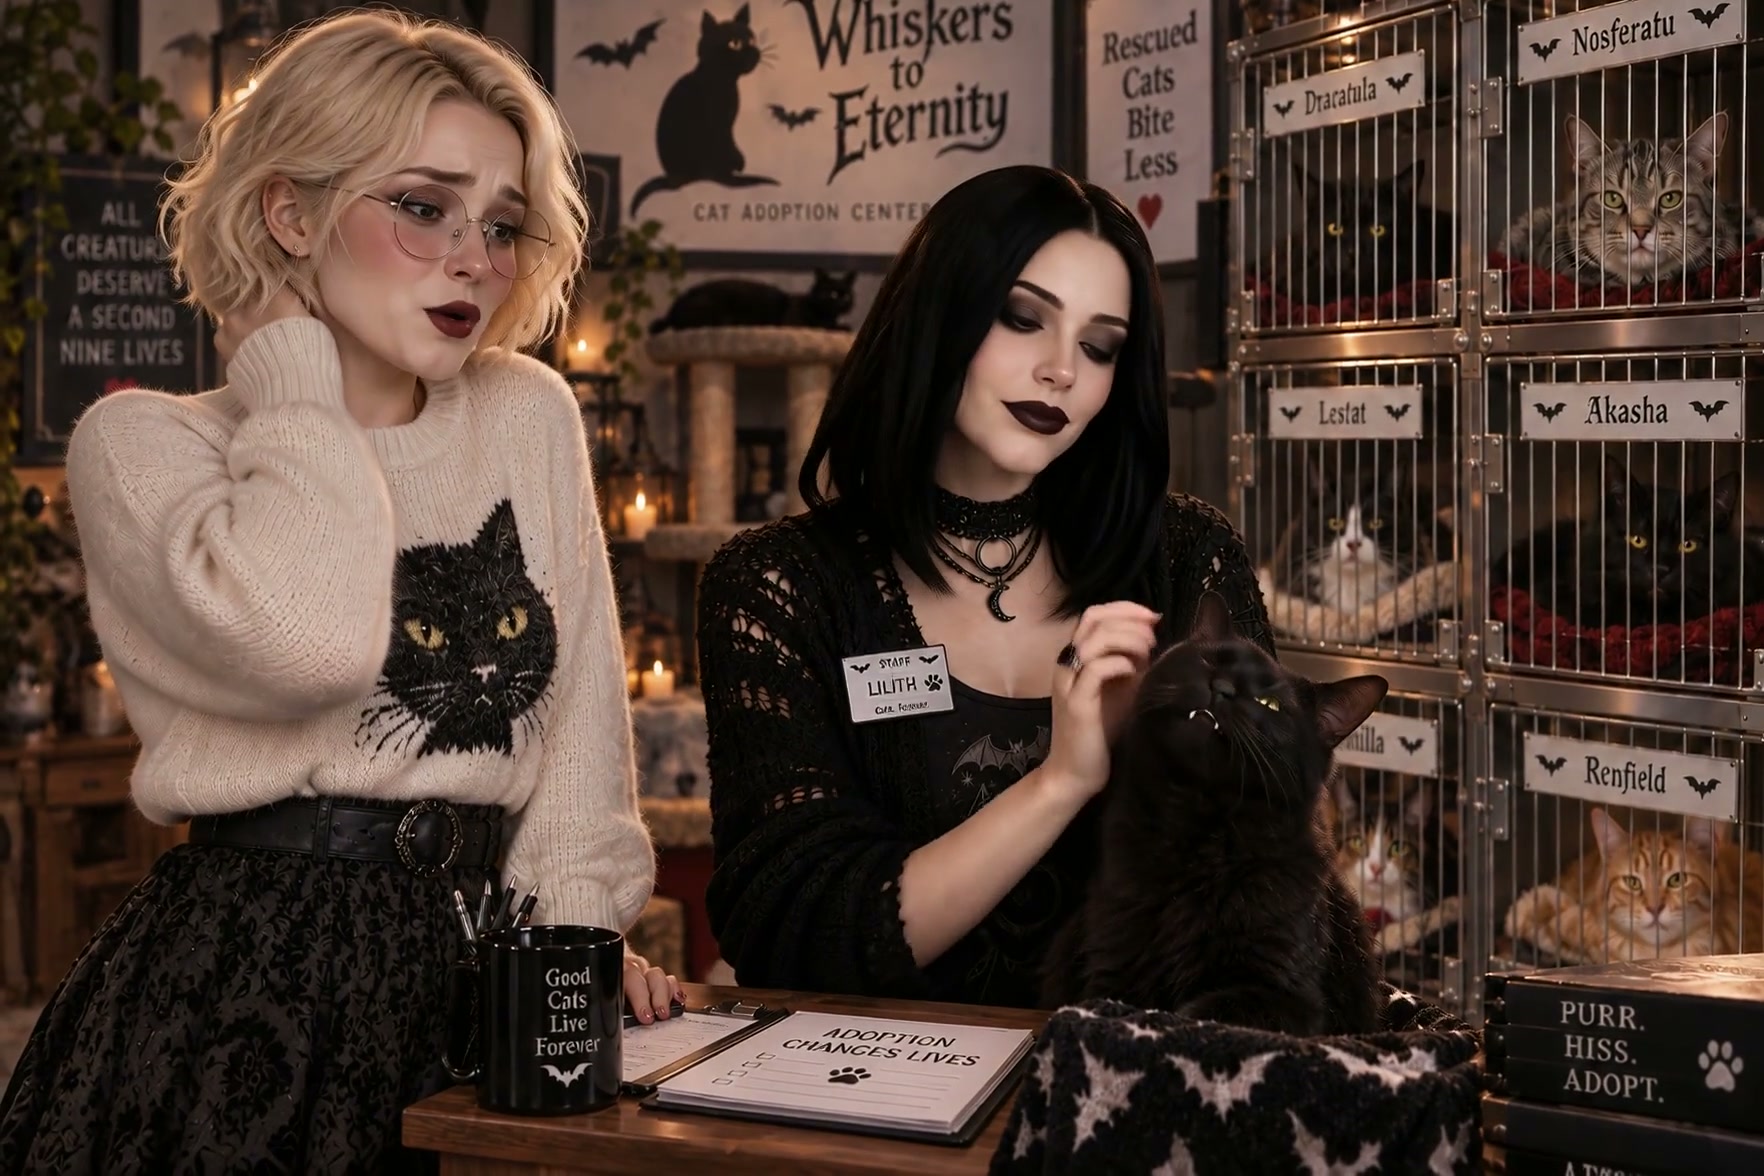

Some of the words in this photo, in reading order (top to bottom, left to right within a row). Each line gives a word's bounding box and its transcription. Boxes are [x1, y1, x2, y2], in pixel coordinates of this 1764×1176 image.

[782, 0, 1013, 71] Whiskers
[1102, 10, 1198, 66] Rescued
[1572, 11, 1676, 56] Nosferatu
[890, 56, 924, 91] to
[1122, 64, 1176, 100] Cats
[1305, 76, 1377, 116] Dracatula
[826, 83, 1009, 186] Eternity
[1126, 104, 1175, 140] Bite
[1124, 148, 1178, 182] Less
[101, 201, 142, 227] ALL
[693, 203, 730, 222] CAT
[741, 203, 839, 222] ADOPTION
[60, 233, 163, 262] CREATUR
[67, 303, 84, 330] A
[91, 303, 176, 331] SECOND
[60, 338, 115, 366] NINE
[123, 338, 185, 366] LIVES
[1318, 400, 1366, 425] Lestat
[1584, 395, 1668, 424] Akasha
[878, 655, 911, 669] STAFF
[867, 676, 918, 697] LILITH
[1584, 755, 1666, 794] Renfield
[545, 966, 591, 987] Good
[547, 990, 588, 1010] Cats
[550, 1014, 588, 1033] Live
[1560, 1000, 1645, 1031] PURR.
[535, 1037, 600, 1056] Forever
[823, 1027, 956, 1048] ADOPTION
[1564, 1034, 1637, 1065] HISS.
[782, 1038, 902, 1059] CHANGES
[906, 1050, 981, 1067] LIVES
[1563, 1068, 1664, 1103] ADOPT.
